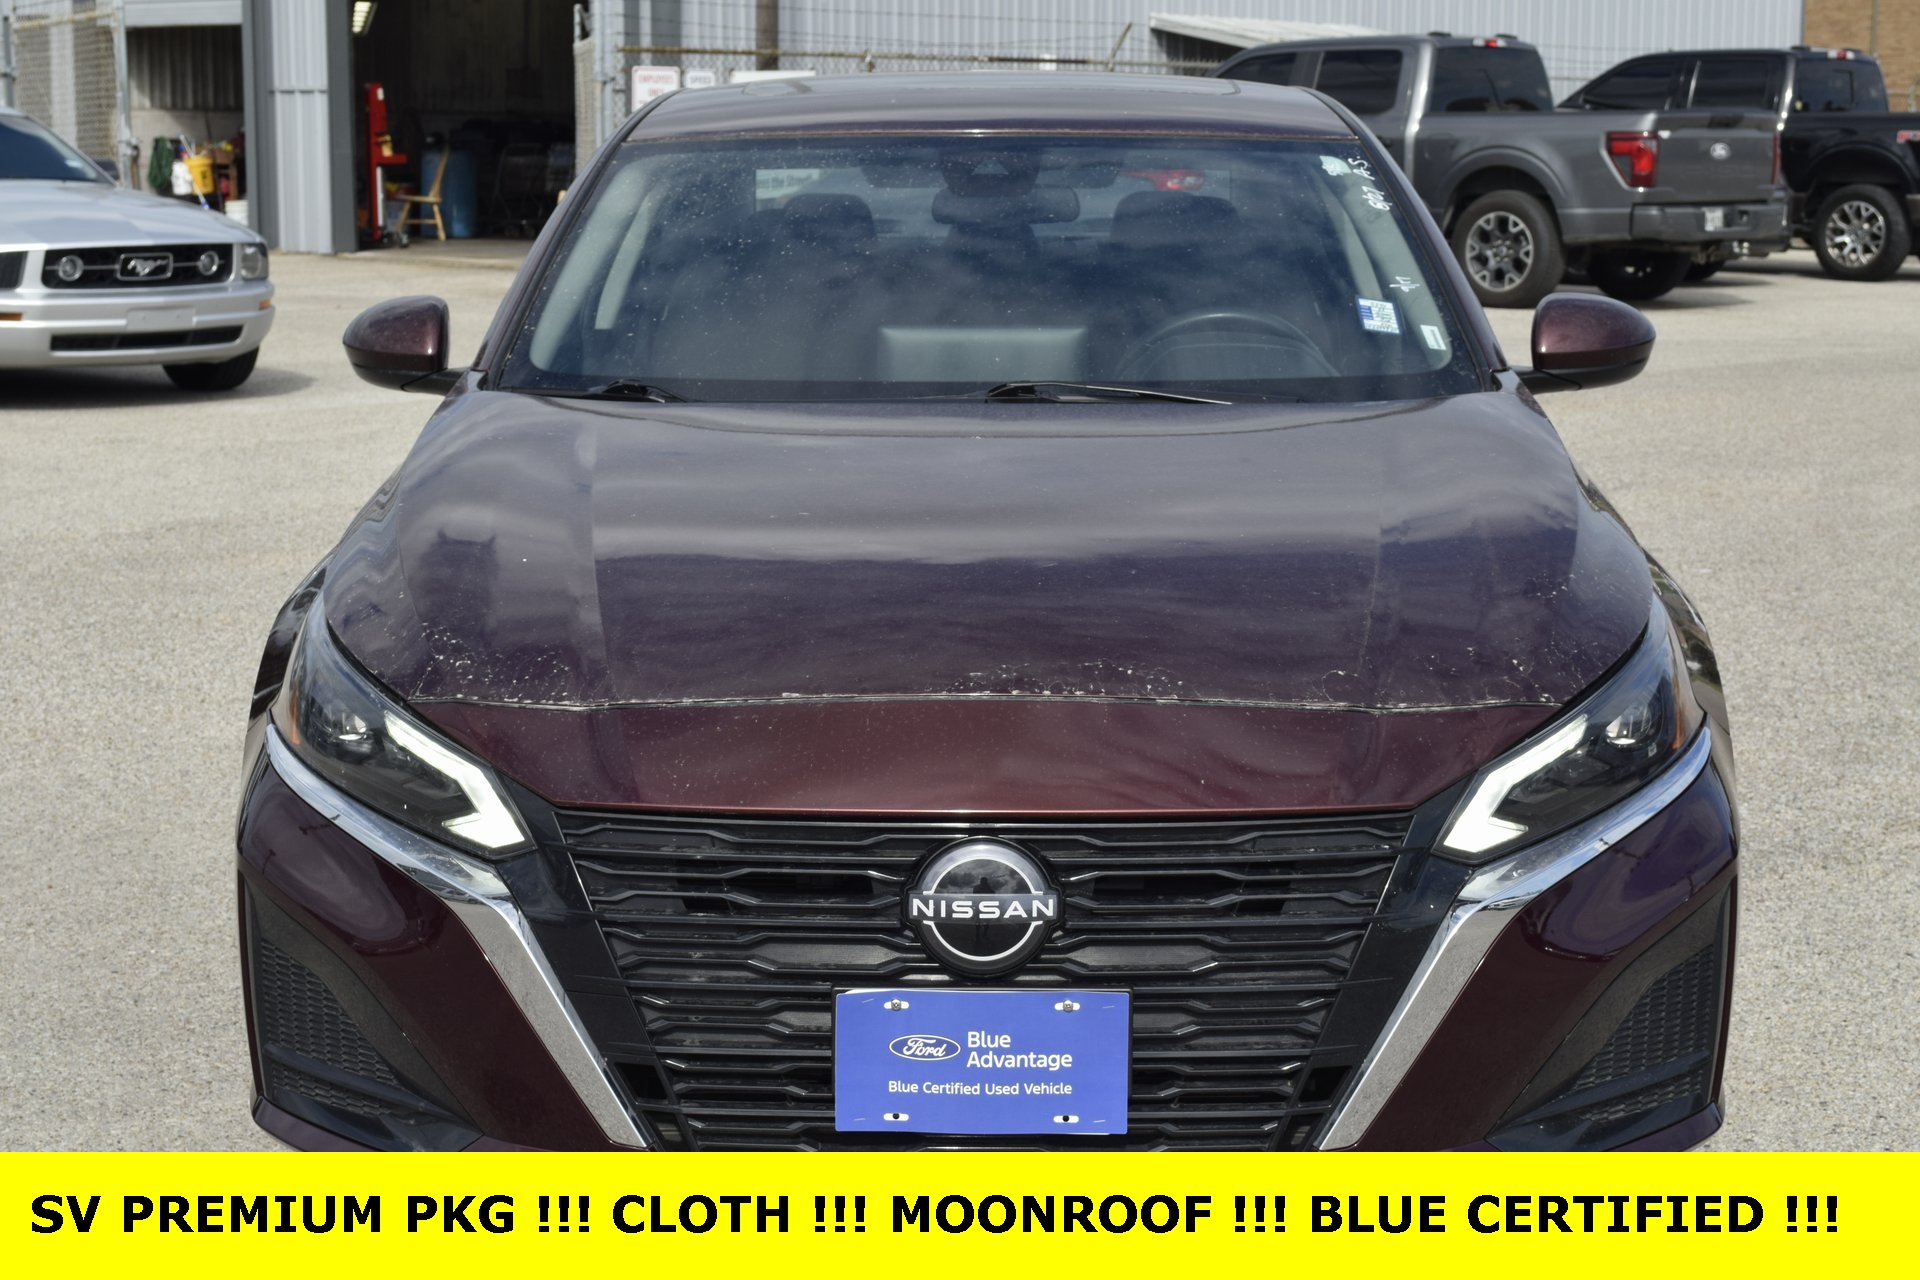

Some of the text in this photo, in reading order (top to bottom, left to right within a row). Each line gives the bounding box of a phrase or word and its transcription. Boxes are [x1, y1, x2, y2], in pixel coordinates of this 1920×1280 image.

[912, 898, 1054, 919] NISSAN
[903, 1038, 946, 1057] Ford
[967, 1031, 1012, 1049] Blue
[966, 1051, 1073, 1071] Advantage
[888, 1080, 1073, 1095] Blue Certified Used Vehicle
